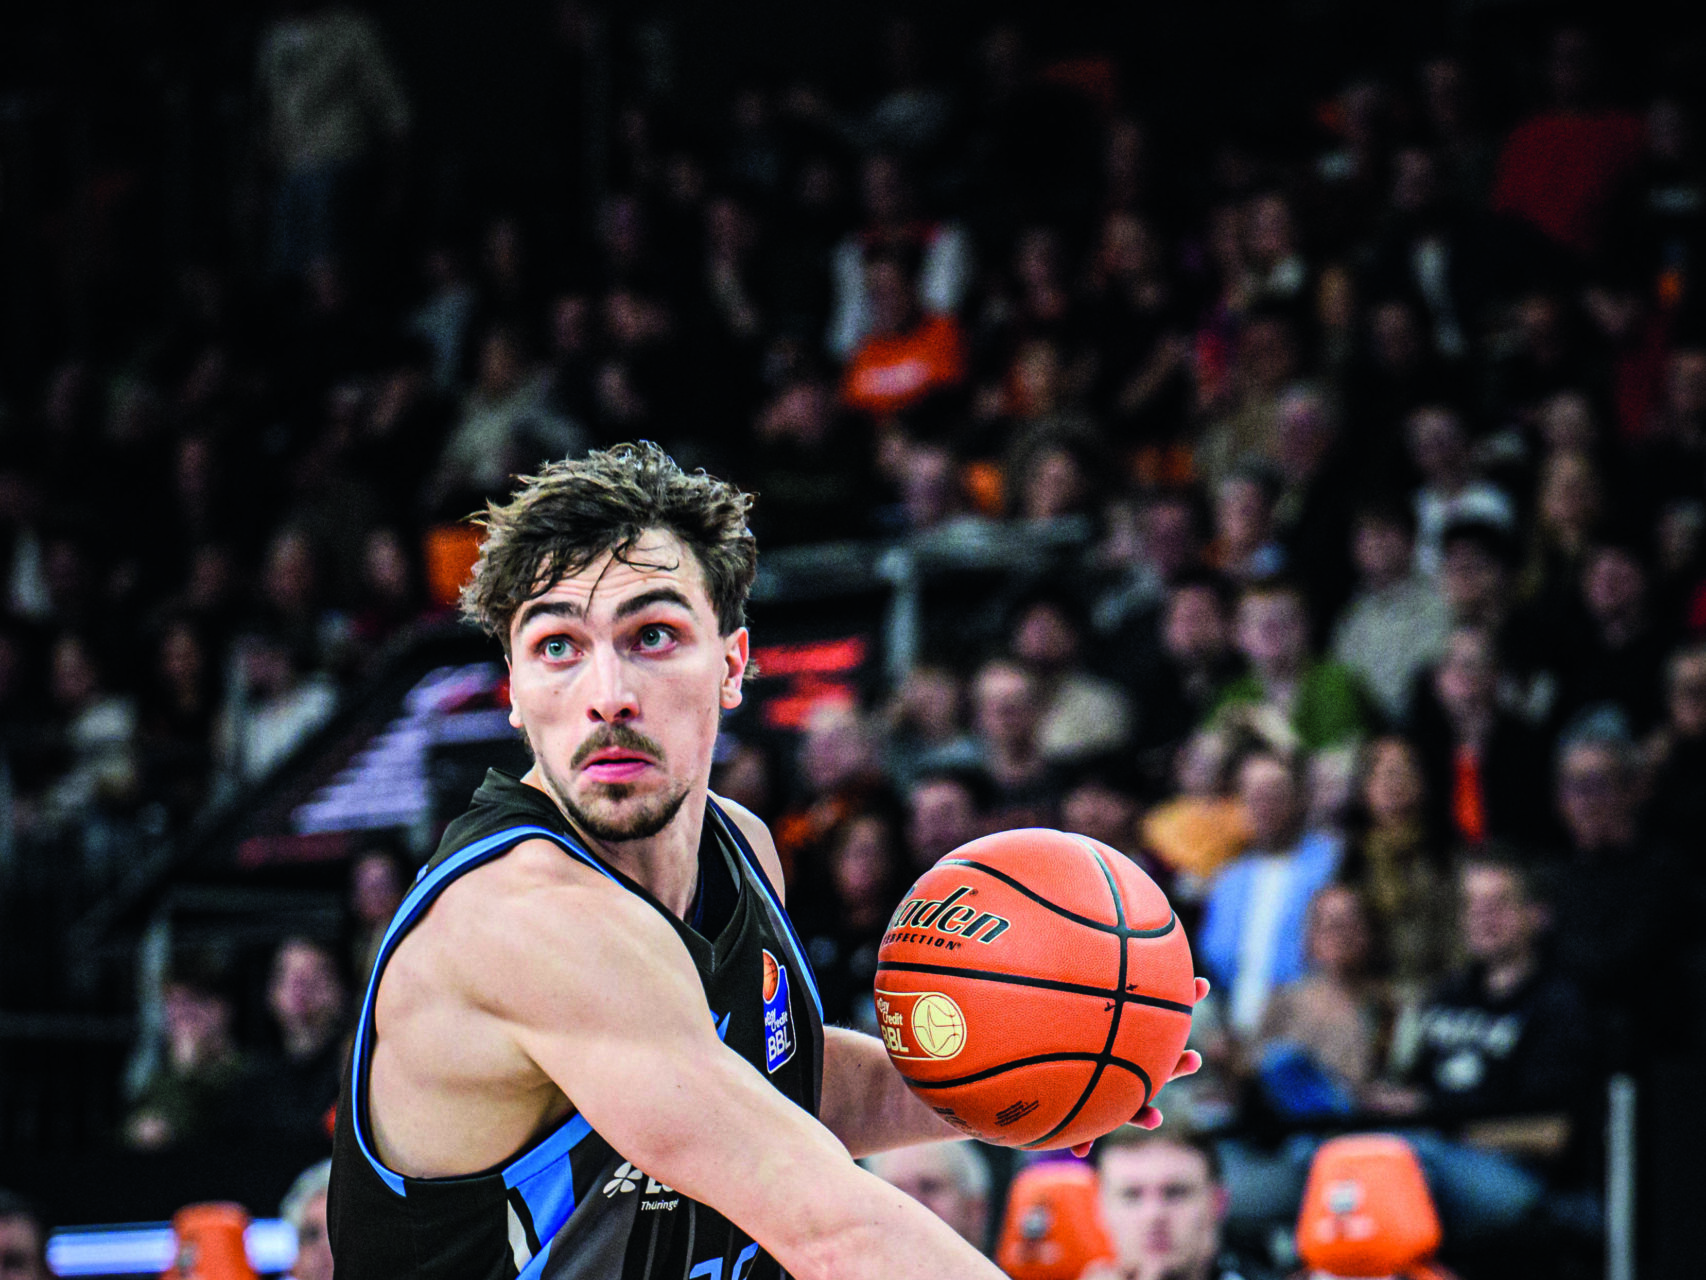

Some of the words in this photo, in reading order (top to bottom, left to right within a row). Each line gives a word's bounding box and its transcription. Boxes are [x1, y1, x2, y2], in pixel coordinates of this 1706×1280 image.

[889, 885, 1011, 945] aden
[768, 1026, 791, 1063] BBL
[881, 1025, 909, 1053] BBL
